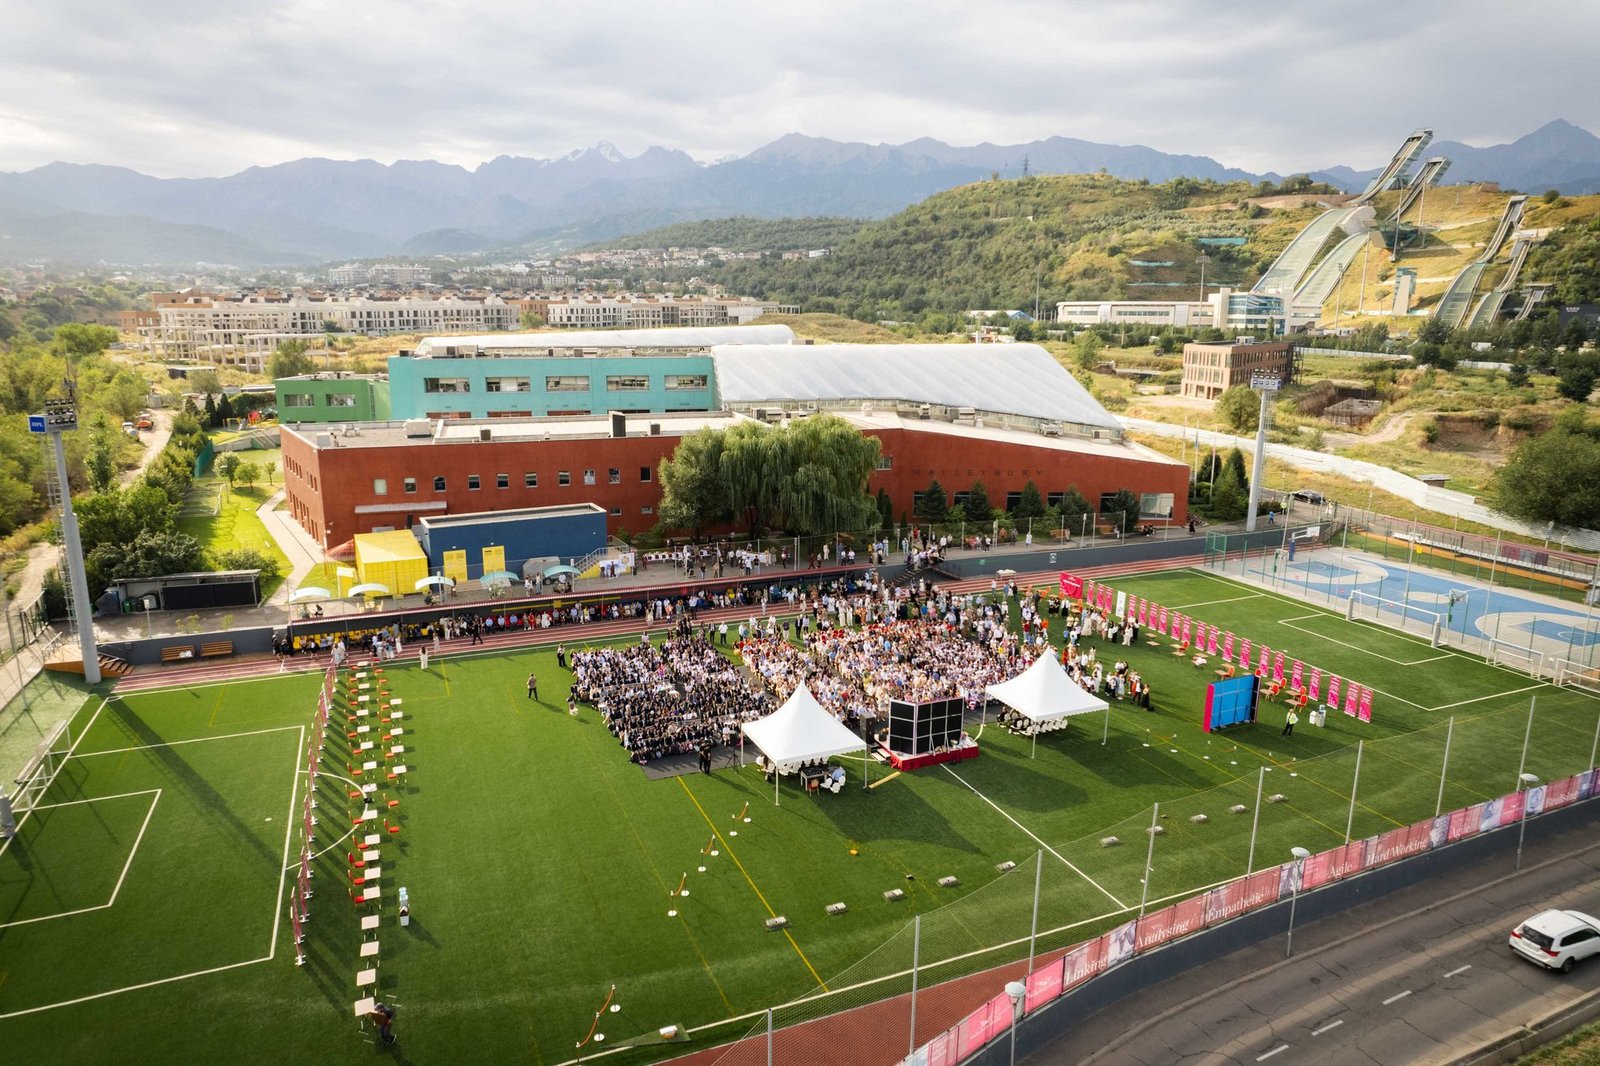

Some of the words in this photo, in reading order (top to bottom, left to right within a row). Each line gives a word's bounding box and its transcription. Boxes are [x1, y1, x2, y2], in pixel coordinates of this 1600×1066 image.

[912, 468, 1043, 477] HAILEYBURY
[1365, 847, 1390, 866] Hard
[1389, 840, 1428, 857] Working
[1328, 861, 1353, 879] Agile
[1205, 892, 1264, 922] Empathetic
[1135, 919, 1190, 947] Analysing
[1064, 956, 1108, 985] Linking
